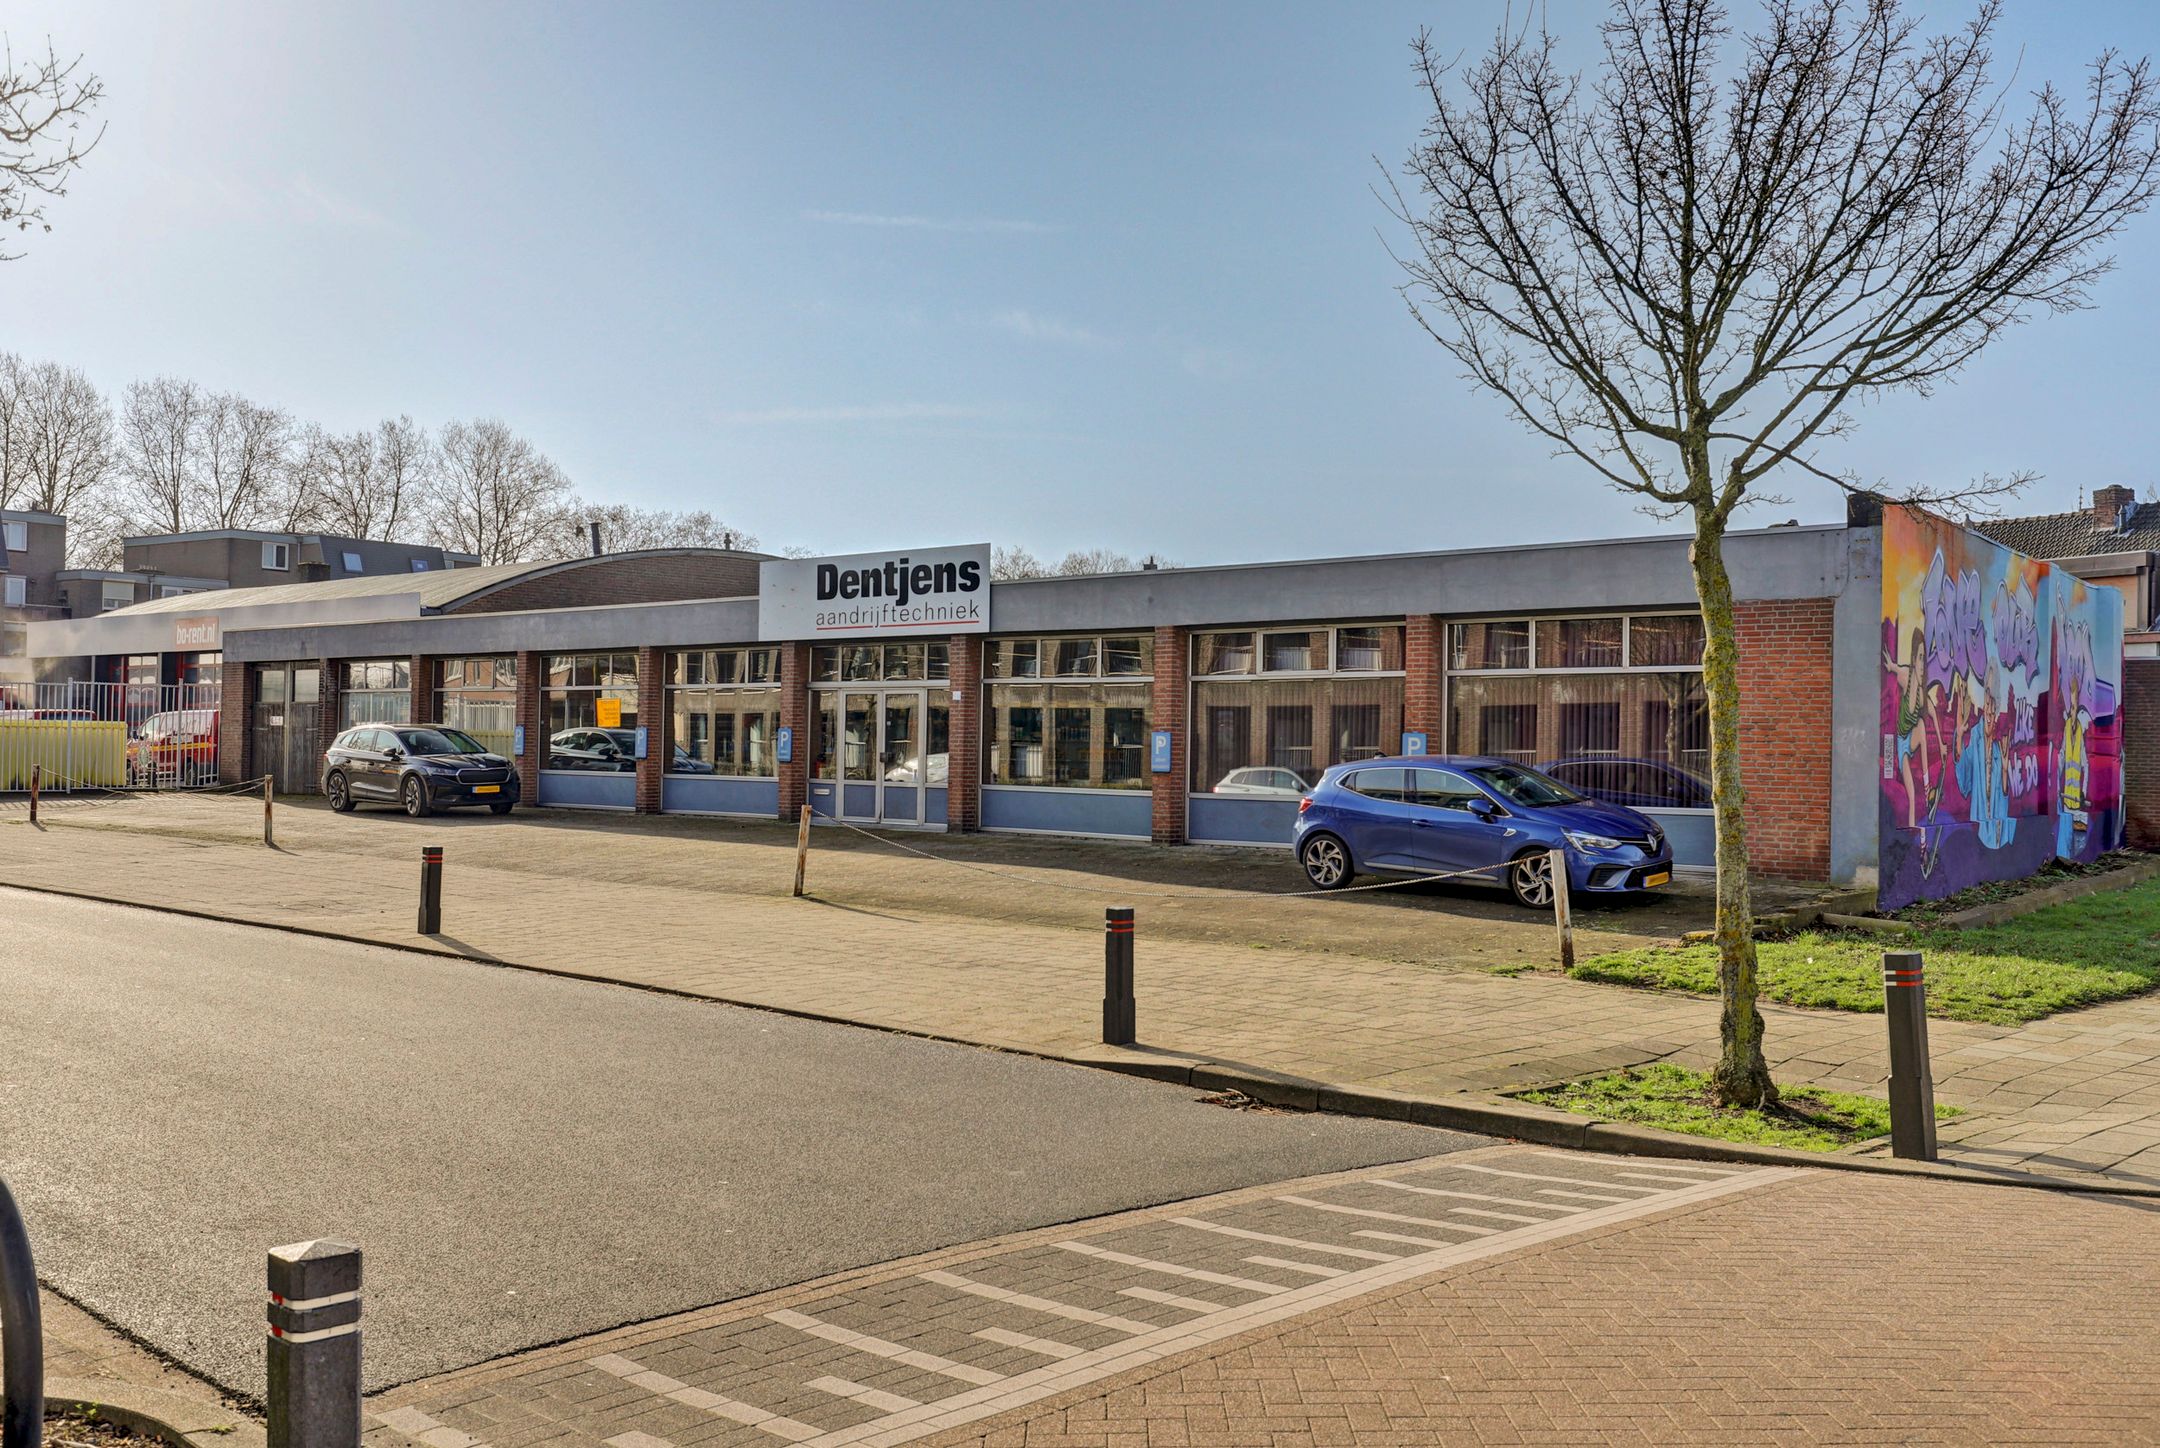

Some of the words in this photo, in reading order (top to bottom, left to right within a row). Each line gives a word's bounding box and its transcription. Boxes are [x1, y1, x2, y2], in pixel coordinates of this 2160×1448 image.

[817, 558, 981, 606] Dentjens
[816, 600, 979, 628] aandrijftechniek
[176, 623, 216, 645] bo-rent.nl
[2014, 697, 2035, 745] LIKE
[637, 730, 644, 745] P
[780, 731, 789, 748] P
[1155, 735, 1167, 755] P
[1408, 736, 1421, 756] P
[2008, 751, 2024, 797] WE
[2025, 753, 2038, 793] DO
